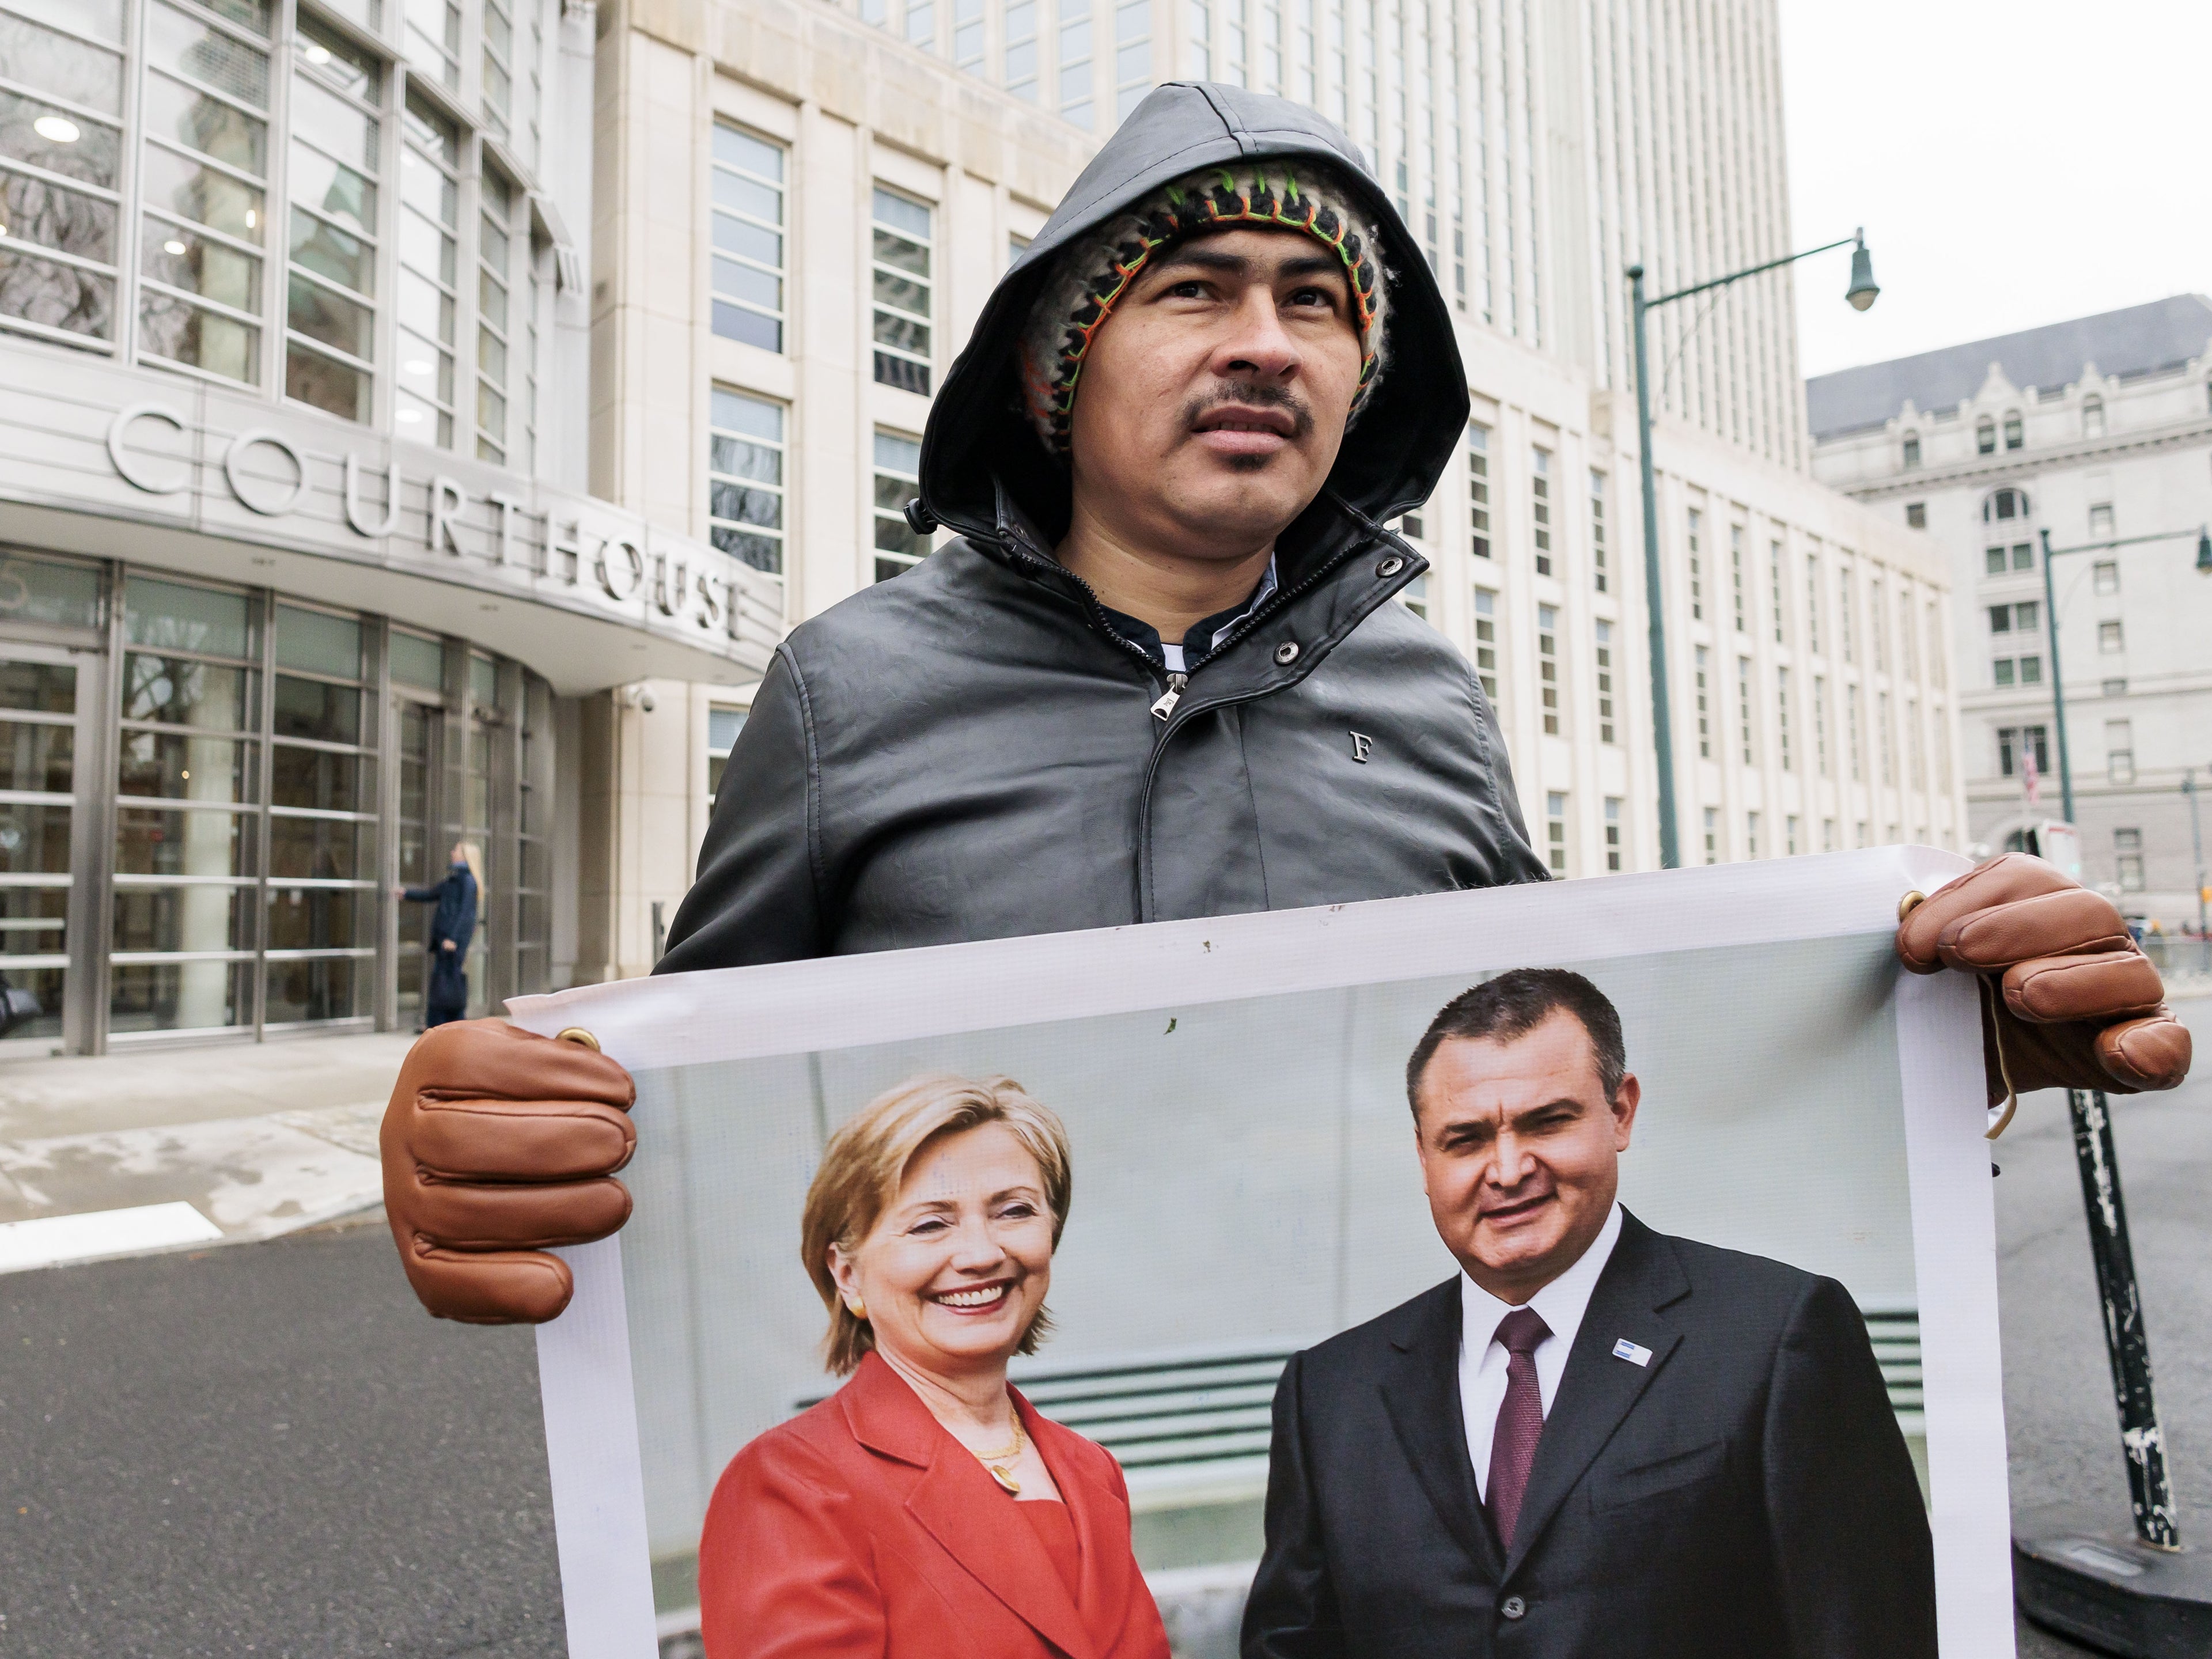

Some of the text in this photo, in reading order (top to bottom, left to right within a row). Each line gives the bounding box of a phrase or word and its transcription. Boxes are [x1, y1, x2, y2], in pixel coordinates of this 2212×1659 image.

[105, 402, 749, 641] COURTHOUSE
[1164, 698, 1175, 706] F
[1349, 730, 1373, 764] F
